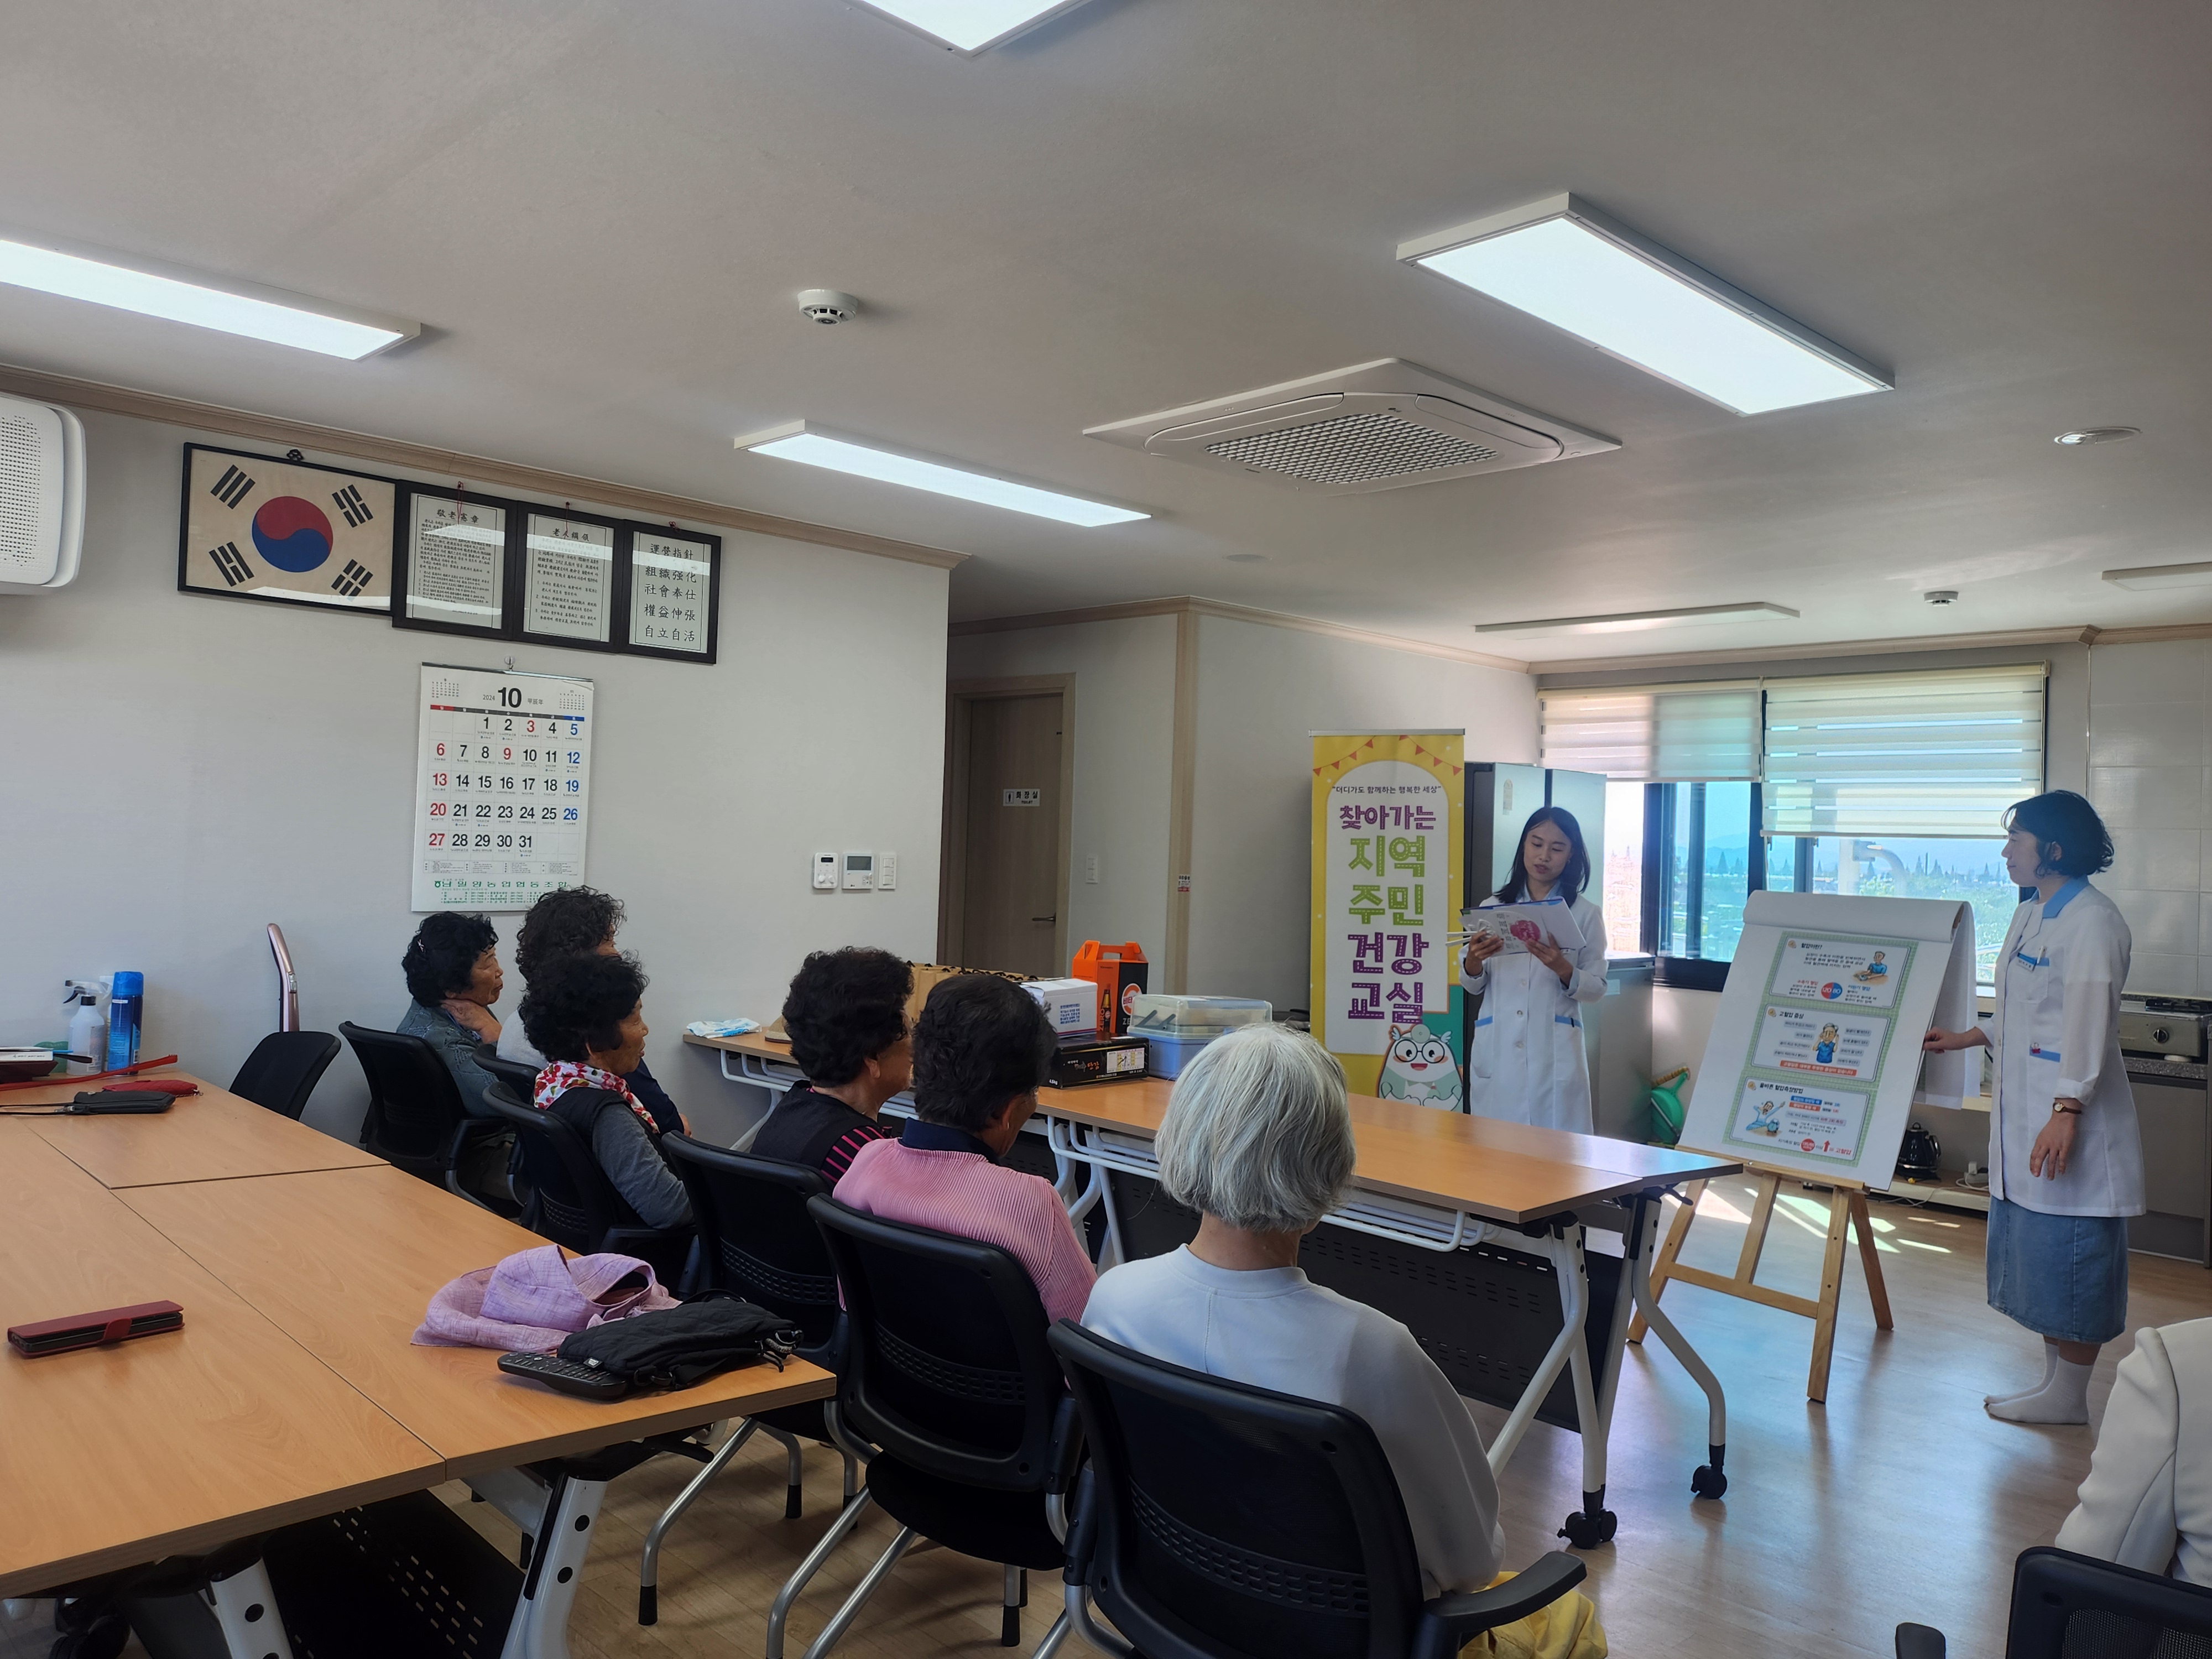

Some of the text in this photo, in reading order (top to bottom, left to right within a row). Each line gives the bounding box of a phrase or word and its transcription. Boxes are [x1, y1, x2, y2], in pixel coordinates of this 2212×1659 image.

[644, 583, 697, 600] 社會奉仕
[644, 603, 696, 621] 權益伸張
[645, 625, 695, 641] 自立自活
[498, 687, 522, 708] 10
[483, 717, 578, 735] 1 2 3 4 5
[436, 743, 580, 764] 6 7 8 9 10 11 12
[432, 773, 579, 792] 13 14 15 16 17 18 19
[1367, 786, 1396, 794] 함께하는
[1399, 786, 1421, 794] 행복한
[1016, 791, 1038, 799] 화장실
[430, 802, 578, 821] 20 21 22 23 24 25 26
[1339, 805, 1436, 830] 찾아가는
[429, 833, 533, 849] 27 28 29 30 31
[1348, 835, 1425, 877] 지역
[1349, 884, 1423, 926] 주민
[1348, 932, 1430, 975] 건강
[1348, 982, 1423, 1024] 교실
